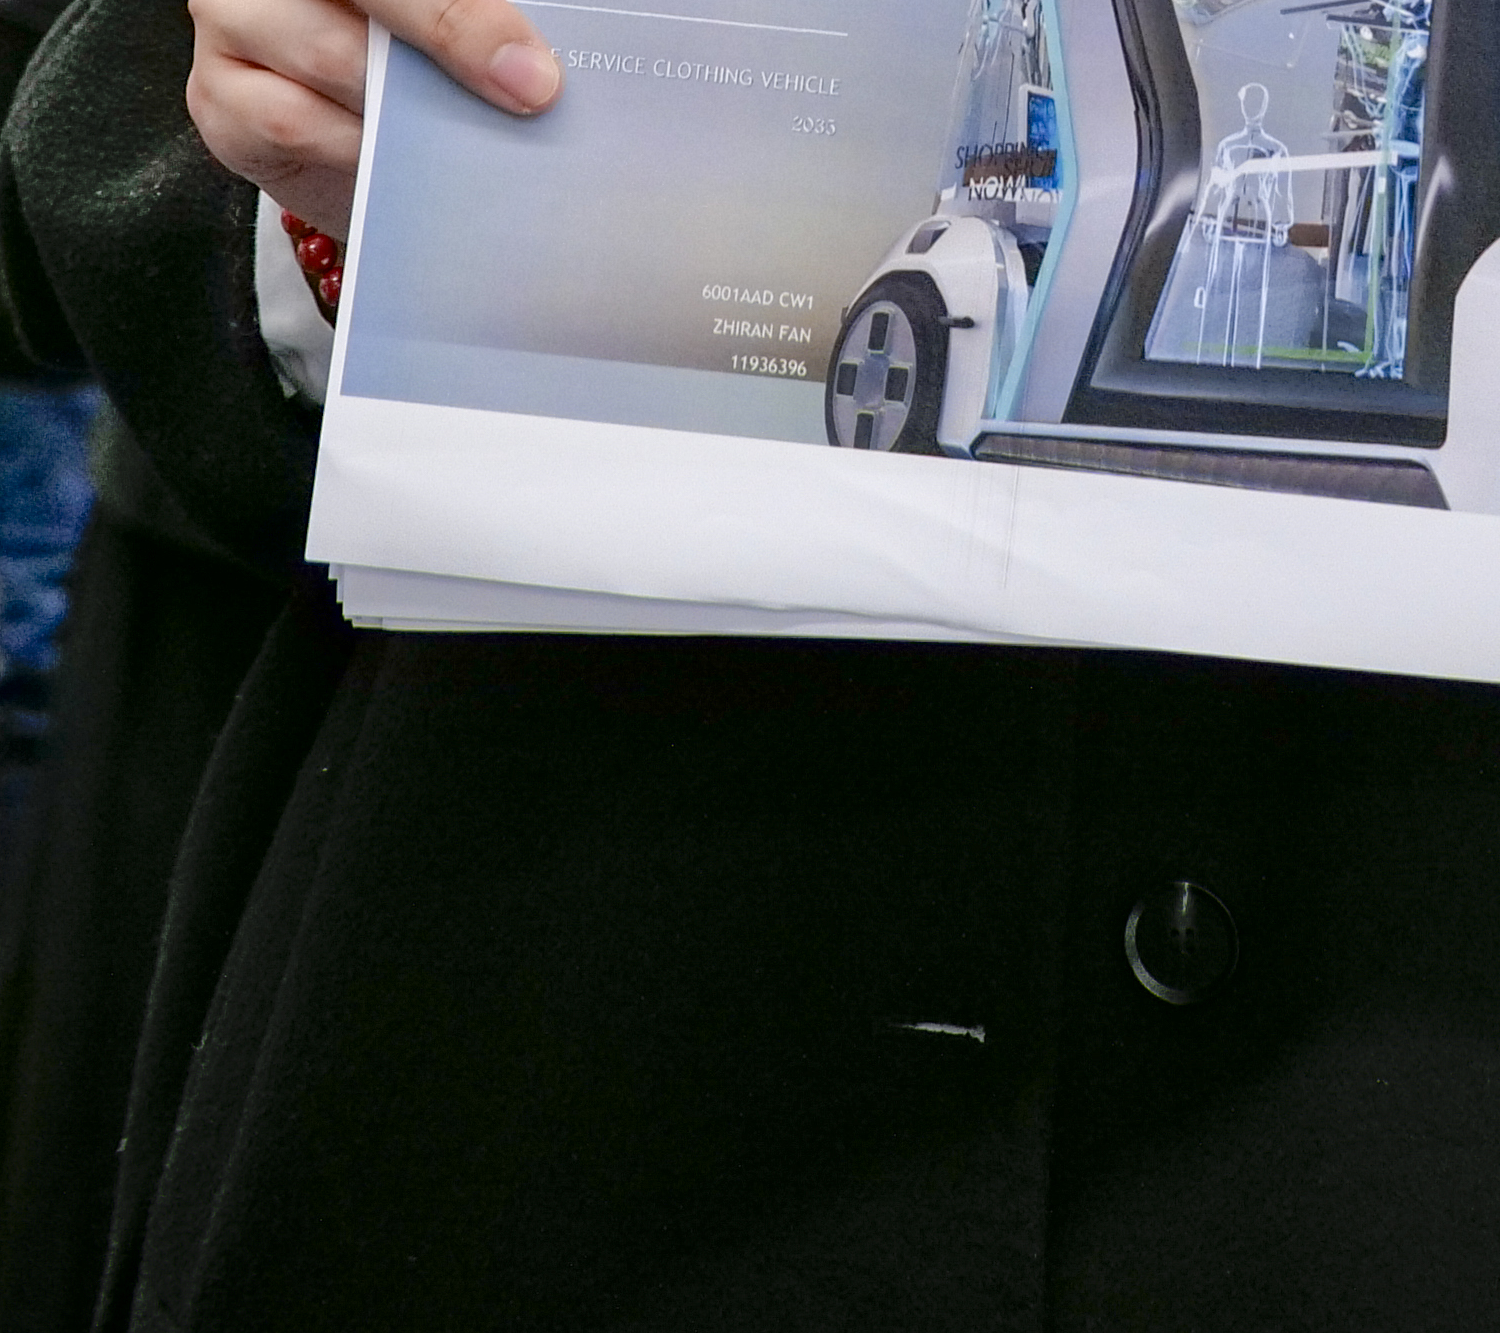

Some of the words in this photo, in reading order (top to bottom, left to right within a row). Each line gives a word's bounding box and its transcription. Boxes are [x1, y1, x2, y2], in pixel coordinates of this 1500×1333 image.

[568, 49, 646, 75] SERVICE
[653, 59, 753, 86] CLOTHING
[761, 71, 841, 96] VEHICLE
[791, 116, 837, 135] 2035
[702, 284, 773, 306] 6001AAD
[779, 292, 813, 310] CW1
[713, 318, 773, 339] ZHIRAN
[779, 325, 812, 343] FAN
[731, 355, 807, 377] 11936396
